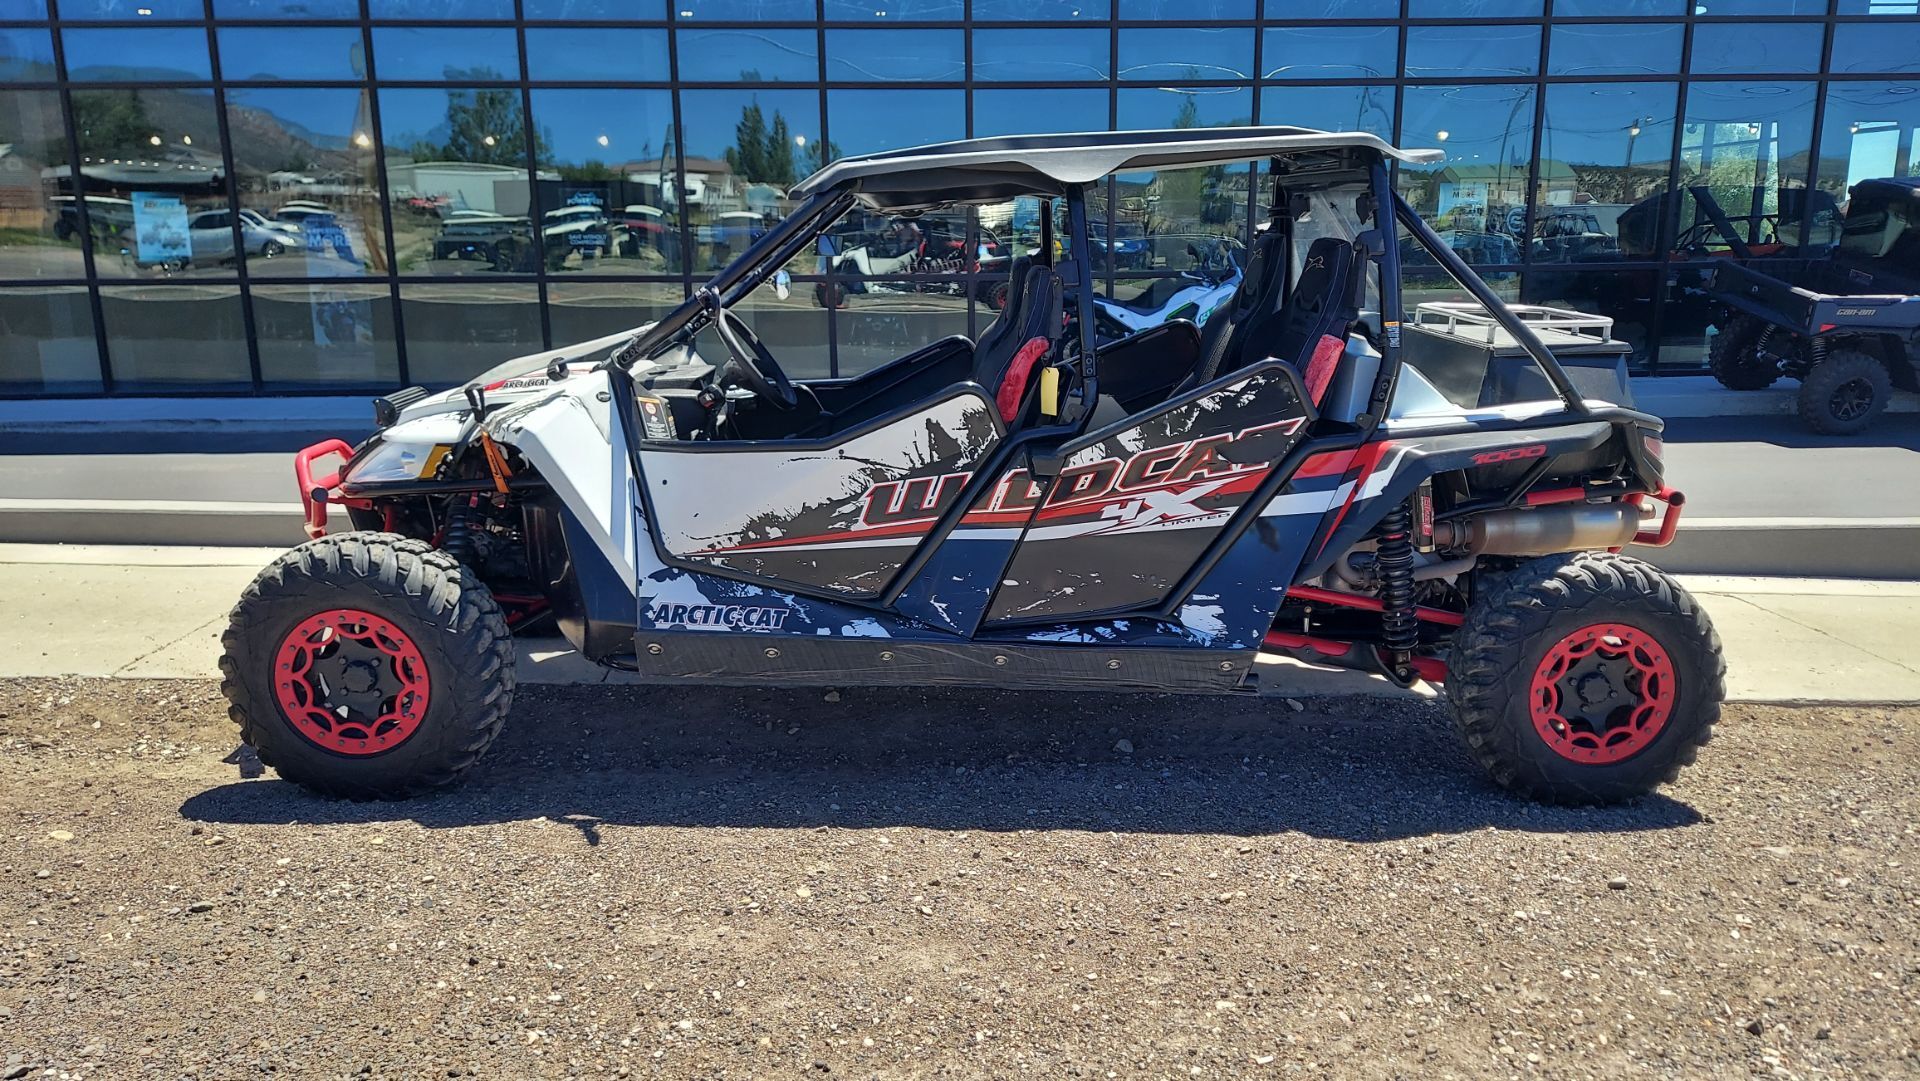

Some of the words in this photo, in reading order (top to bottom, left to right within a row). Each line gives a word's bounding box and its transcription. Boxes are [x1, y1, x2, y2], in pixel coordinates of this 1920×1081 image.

[503, 380, 533, 388] ARCTIC
[1471, 444, 1548, 465] 1000
[1101, 475, 1245, 525] 4X
[1161, 512, 1232, 528] LIMITED
[653, 602, 740, 626] ARCTIC
[742, 606, 789, 629] CAT
